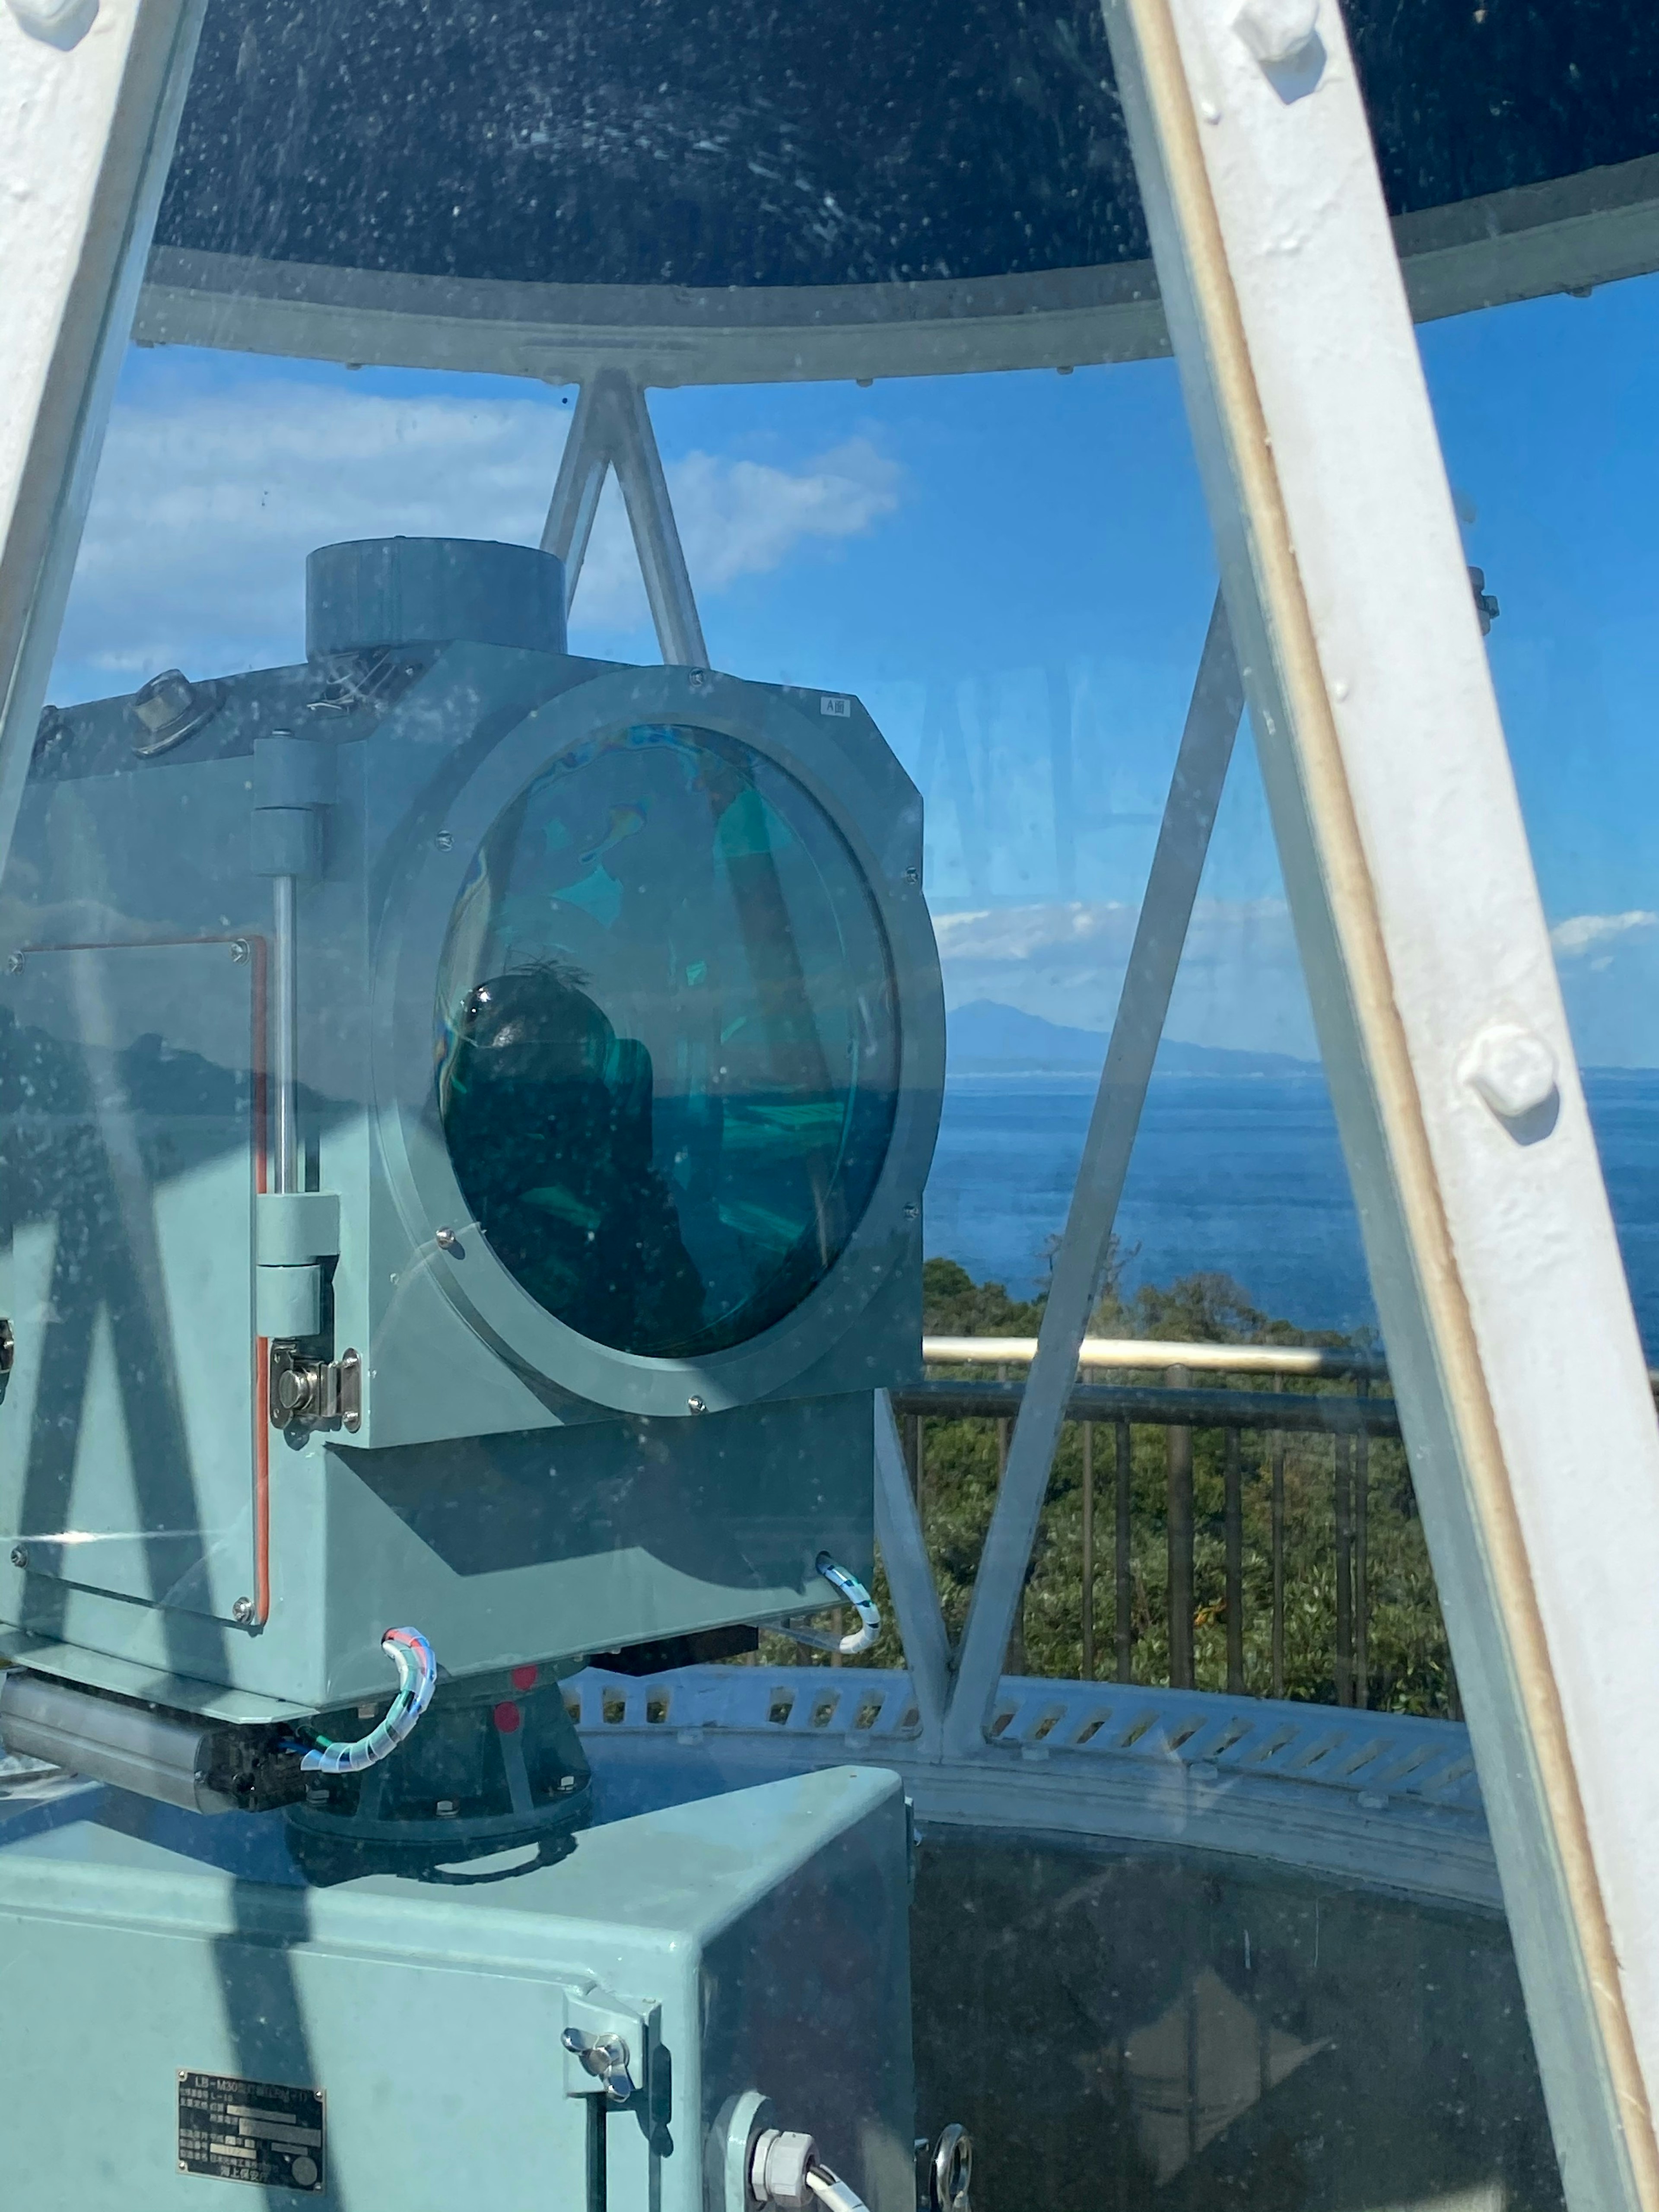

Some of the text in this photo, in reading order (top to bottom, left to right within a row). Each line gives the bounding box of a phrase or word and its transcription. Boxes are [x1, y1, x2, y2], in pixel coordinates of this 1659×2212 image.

[827, 699, 844, 714] A面
[221, 2165, 268, 2183] 海上保安庁
